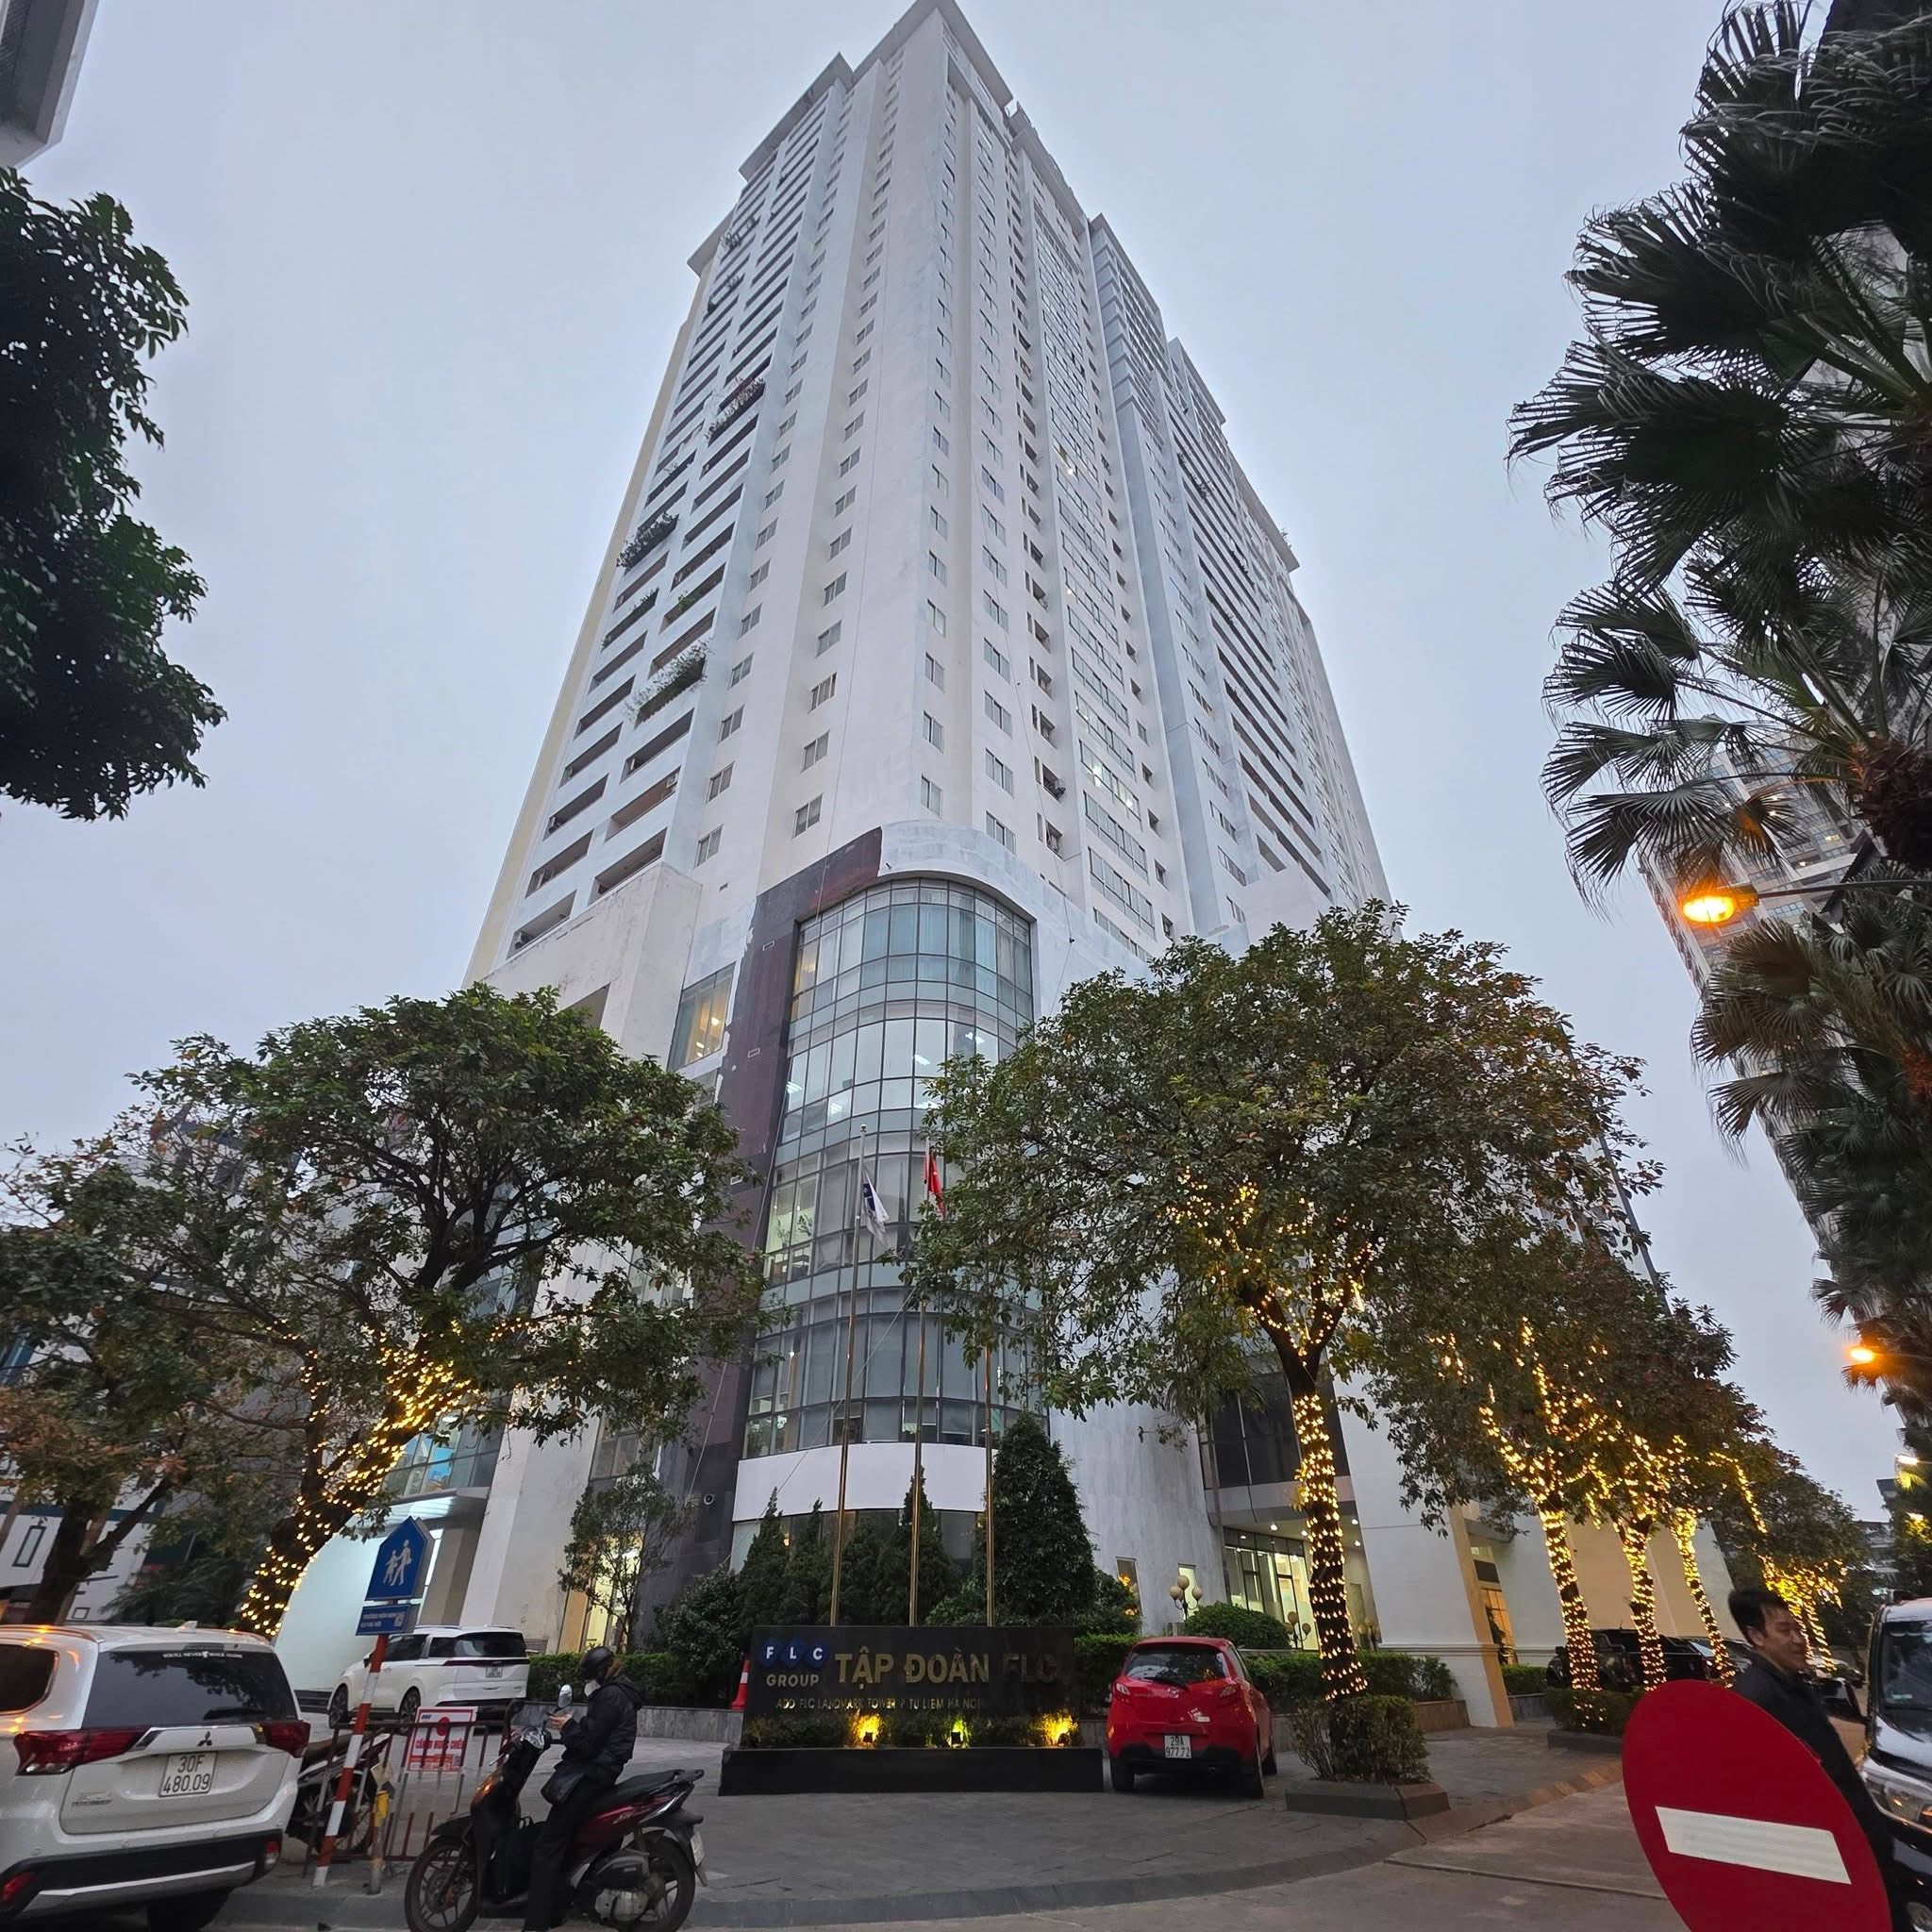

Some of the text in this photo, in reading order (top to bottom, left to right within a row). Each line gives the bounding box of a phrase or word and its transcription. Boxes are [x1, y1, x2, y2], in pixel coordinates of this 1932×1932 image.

[835, 1646, 894, 1690] TẬP
[904, 1647, 990, 1684] ĐOÀN
[766, 1674, 820, 1688] GROUP
[867, 1698, 896, 1709] TOWER
[177, 1755, 205, 1774] 30F
[162, 1774, 210, 1793] 480.09
